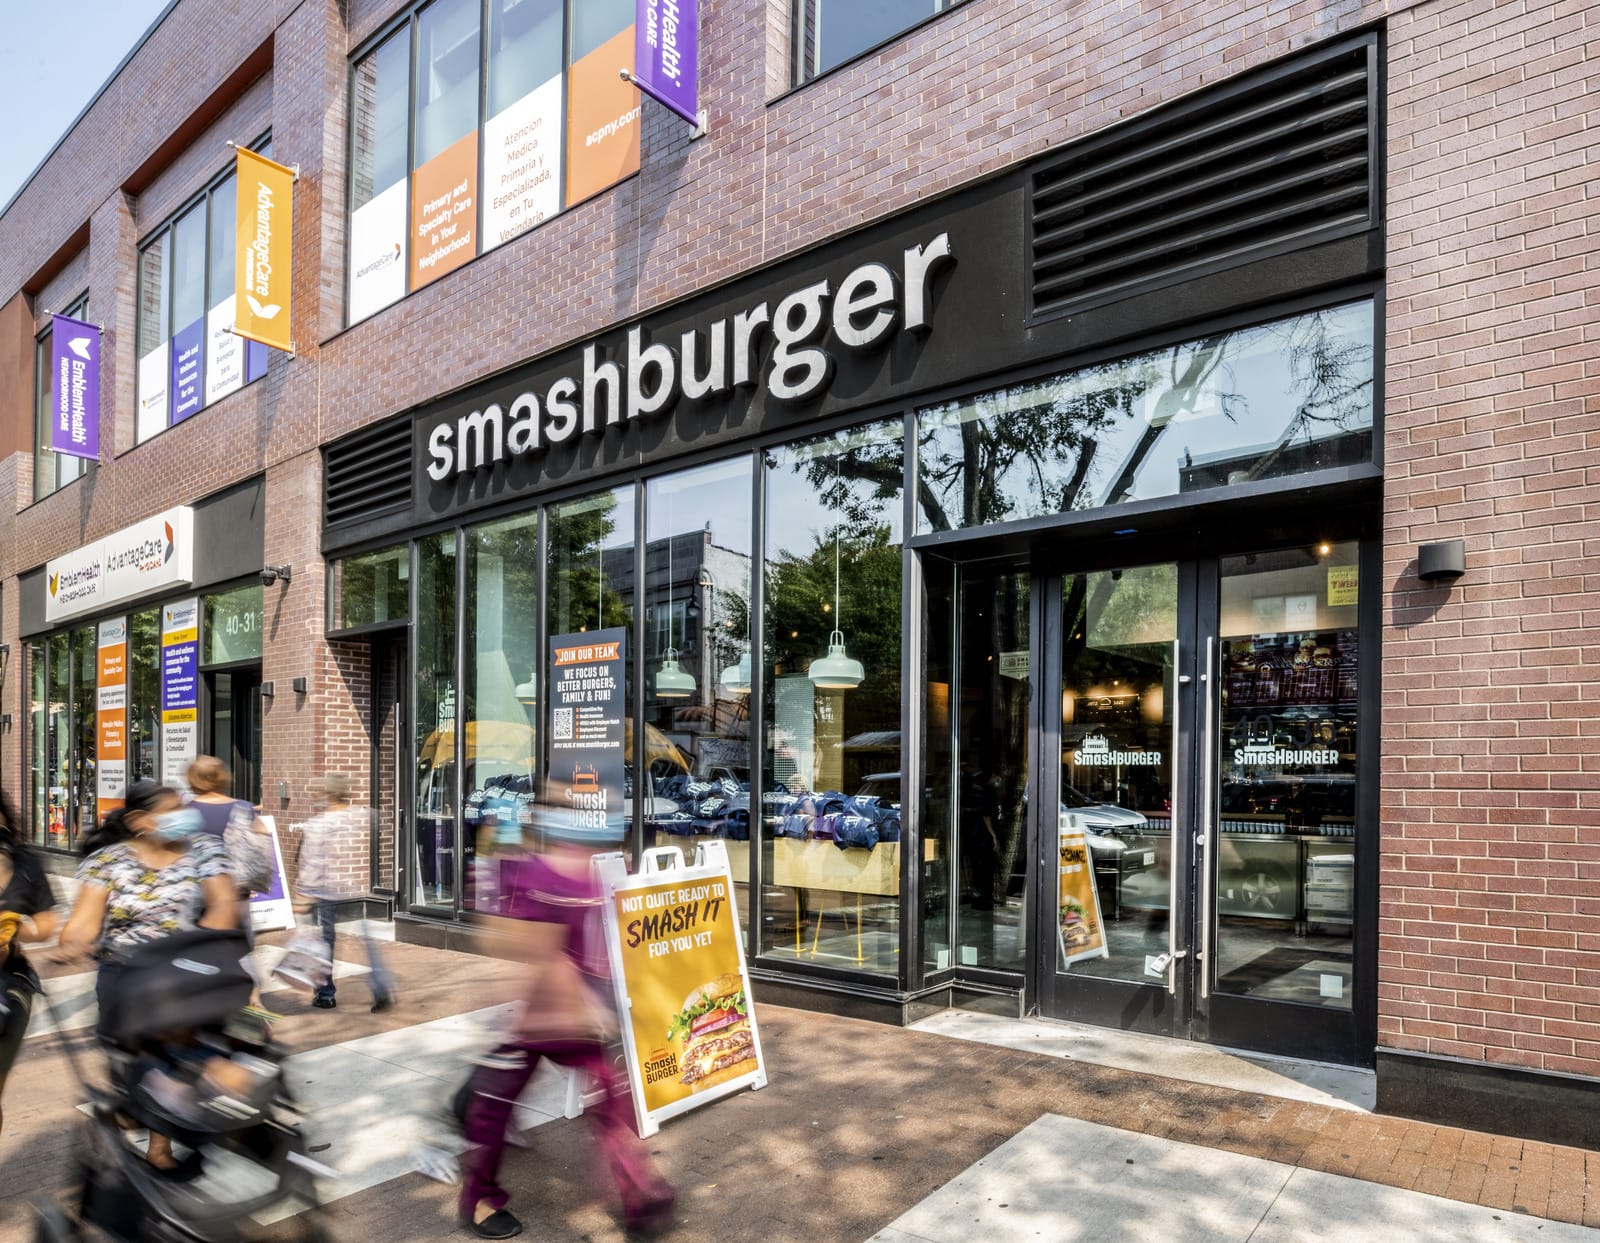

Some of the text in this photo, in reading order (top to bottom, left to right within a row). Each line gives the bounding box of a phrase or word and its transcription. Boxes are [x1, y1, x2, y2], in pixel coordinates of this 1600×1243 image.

[662, 0, 681, 80] Health
[423, 178, 468, 216] Primary and
[510, 198, 533, 218] en Tu
[419, 197, 472, 237] Specialty Care
[500, 211, 544, 242] Vecindario
[252, 181, 274, 297] AdvantageCare
[431, 223, 457, 245] in Your
[419, 230, 471, 270] Neighborhood
[427, 232, 951, 481] smashburger
[72, 360, 86, 445] EmblemHealth
[106, 539, 162, 573] AdvantageCare
[226, 612, 255, 636] 40-31
[560, 645, 614, 662] JOIN OUR TEAM
[557, 677, 617, 692] BETTER BURGERS,
[564, 665, 609, 680] WE FOCUS ON
[562, 689, 611, 703] FAMILY & FUN!
[621, 883, 725, 913] NOT QUITE READY TO
[627, 897, 725, 948] SMASH IT
[648, 930, 712, 958] FOR YOU YET
[646, 1065, 679, 1084] BURGER
